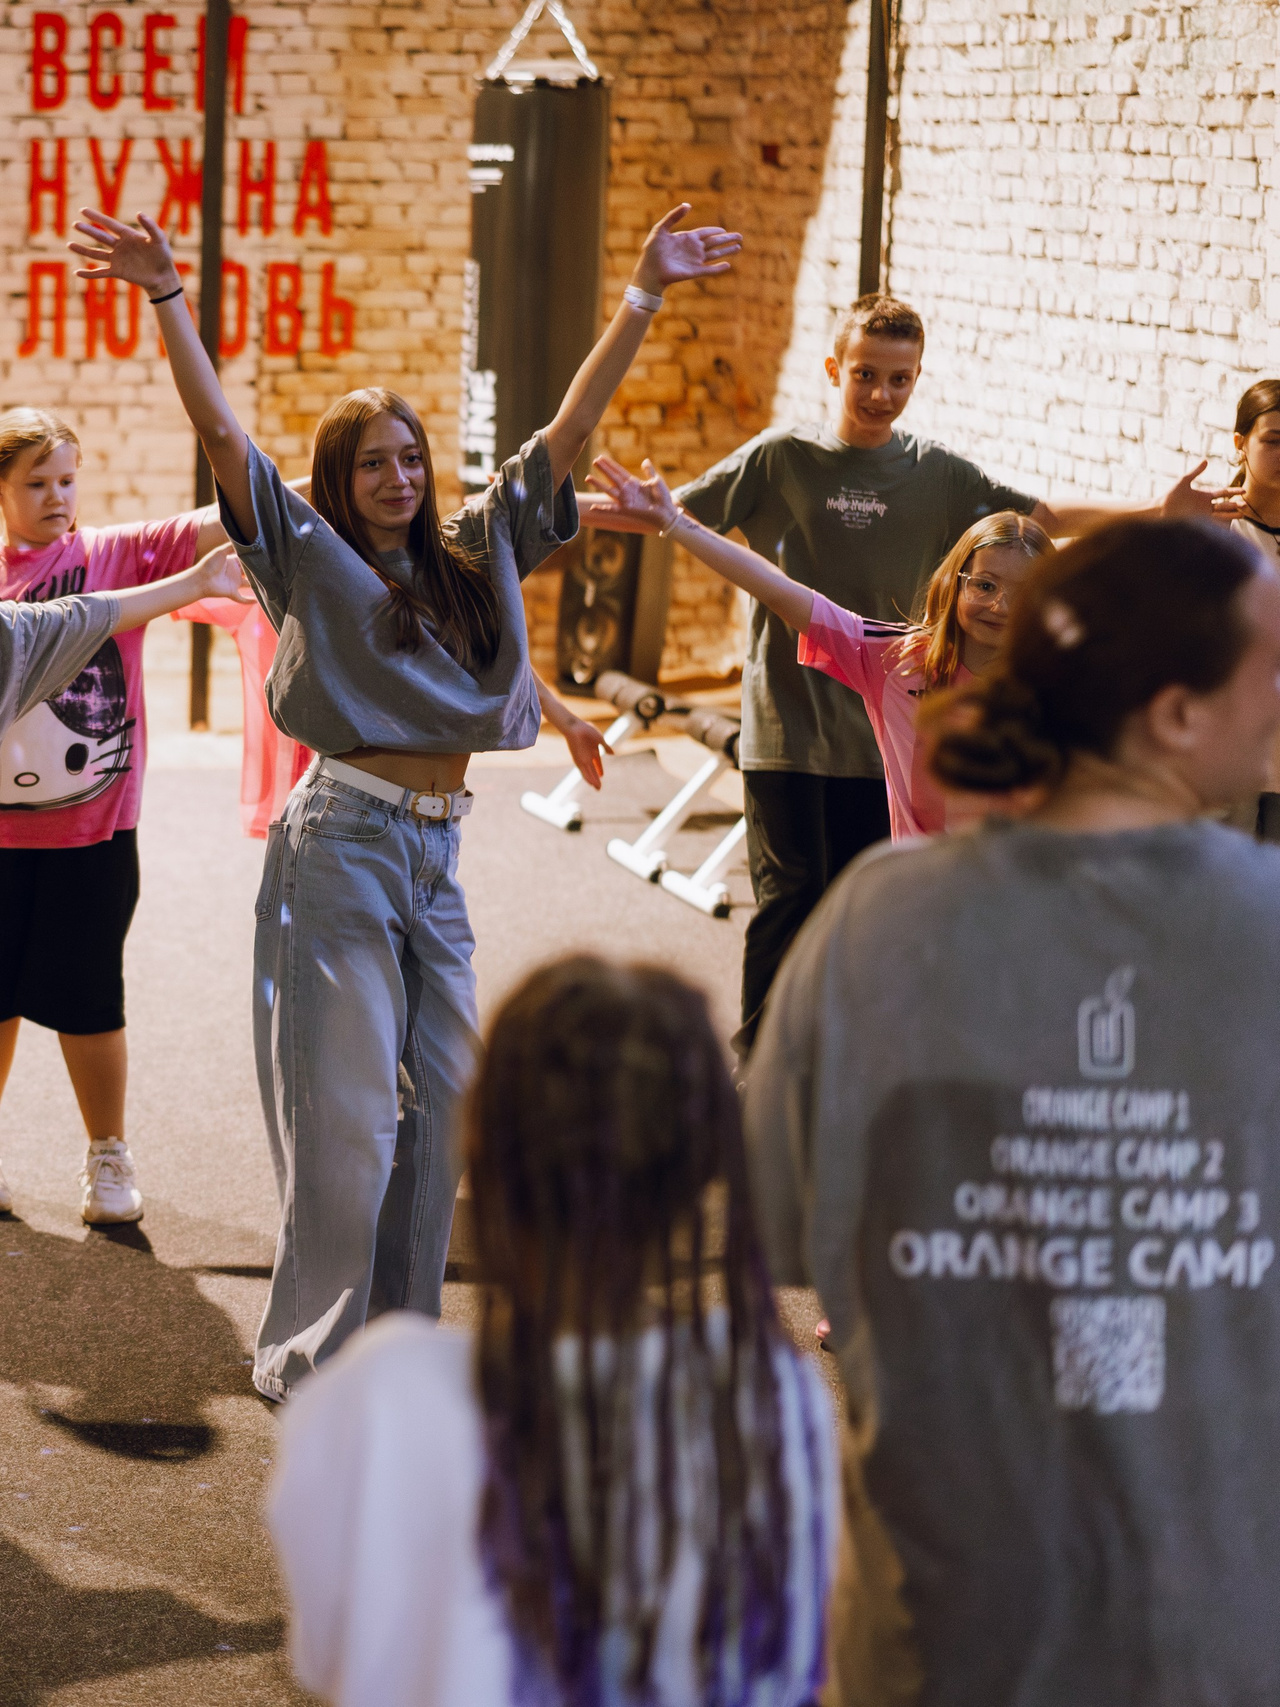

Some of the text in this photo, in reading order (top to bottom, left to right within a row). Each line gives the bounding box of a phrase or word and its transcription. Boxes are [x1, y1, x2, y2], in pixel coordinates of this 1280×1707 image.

[30, 136, 333, 238] НУЖНА
[1023, 1084, 1110, 1130] ORANGE
[1112, 1086, 1174, 1131] CAMP
[990, 1134, 1224, 1181] ORANGE CAMP 2
[954, 1180, 1112, 1229] ORANGE
[1121, 1187, 1229, 1233] CAMP
[888, 1230, 1276, 1290] ORANGE CAMP
